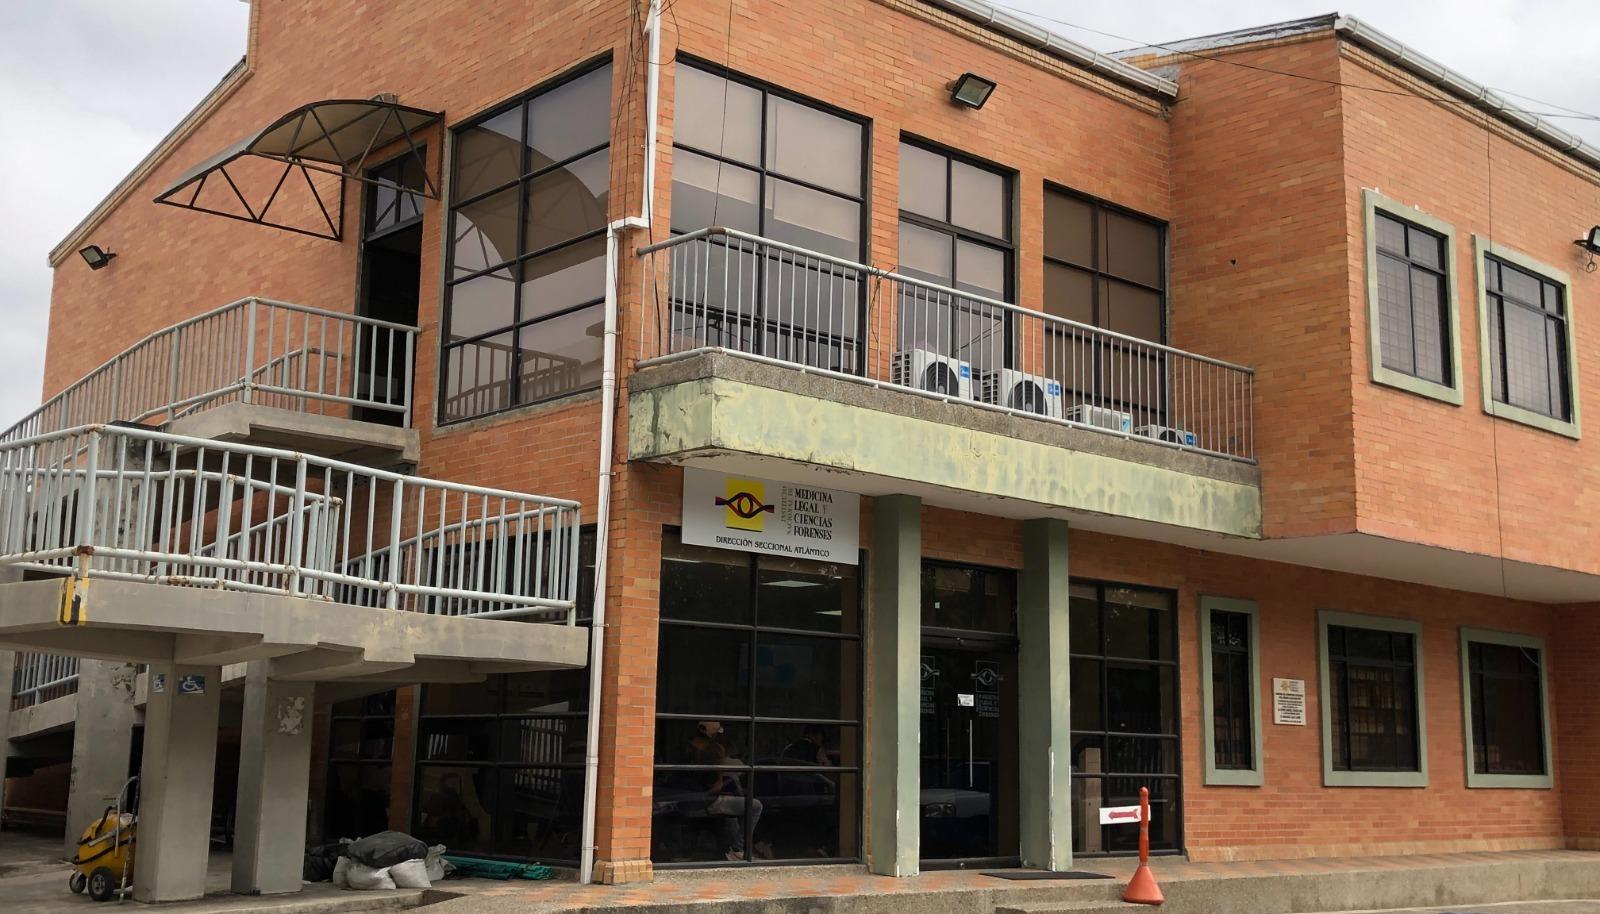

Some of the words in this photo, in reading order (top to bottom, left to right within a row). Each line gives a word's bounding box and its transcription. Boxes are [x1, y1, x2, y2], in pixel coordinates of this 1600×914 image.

[795, 488, 832, 503] MEDICINA
[794, 501, 819, 513] LEGAL
[823, 504, 828, 514] Y
[794, 513, 832, 527] CIENCIAS
[794, 526, 832, 540] FORENSES
[716, 536, 752, 547] DIRECCIÓN
[755, 541, 792, 552] SECCIONAL
[795, 546, 829, 557] ATLÁNTICO
